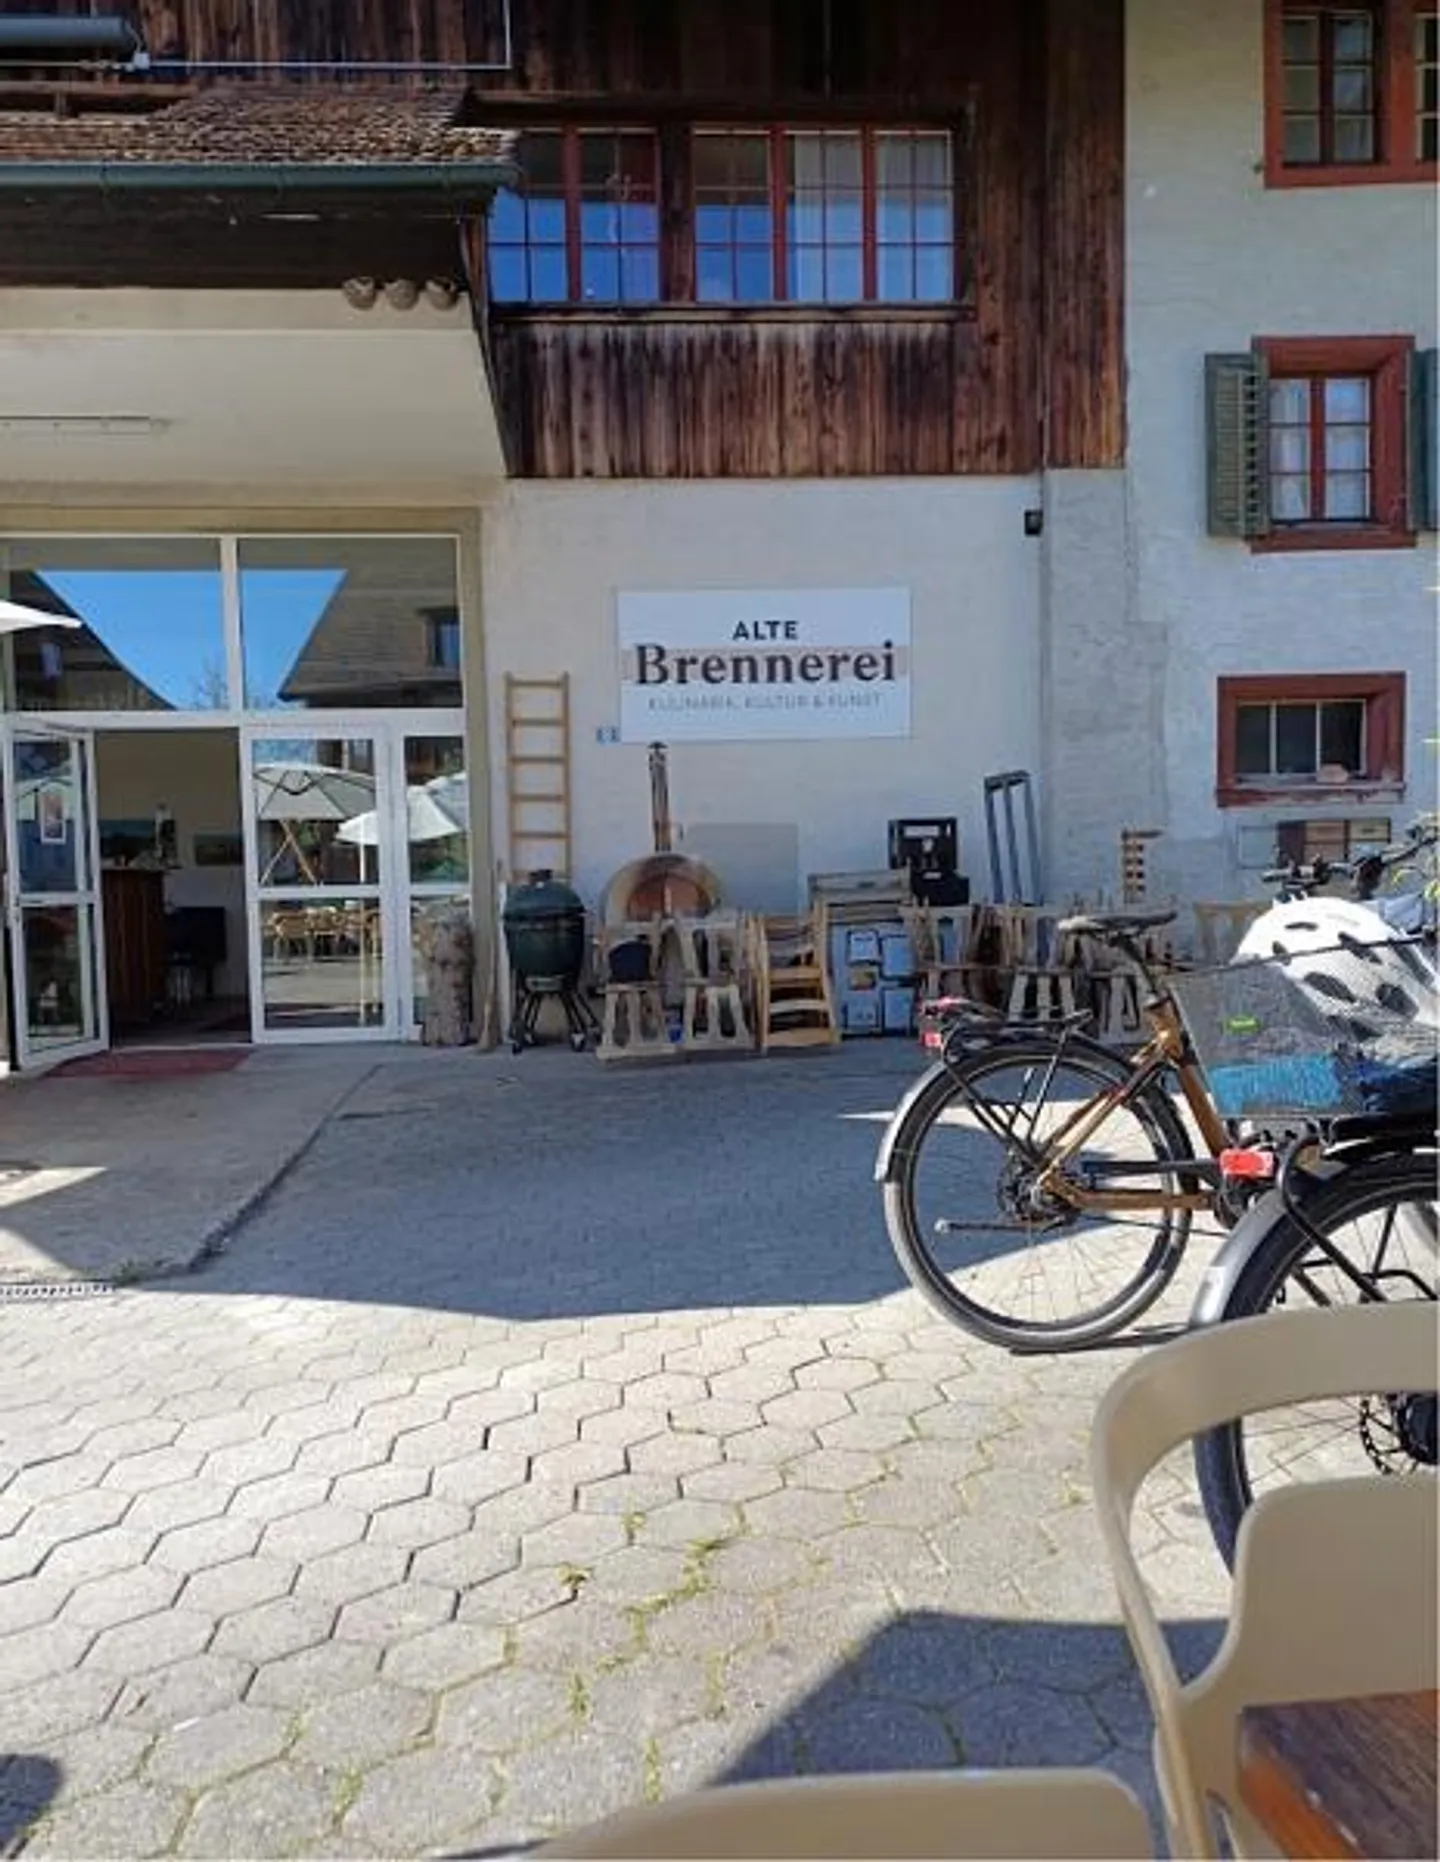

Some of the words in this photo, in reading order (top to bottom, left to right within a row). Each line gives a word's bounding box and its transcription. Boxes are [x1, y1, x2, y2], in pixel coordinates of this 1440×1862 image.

[732, 620, 798, 640] ALTE
[635, 640, 894, 685] Brennerei
[745, 693, 808, 709] KULTUR
